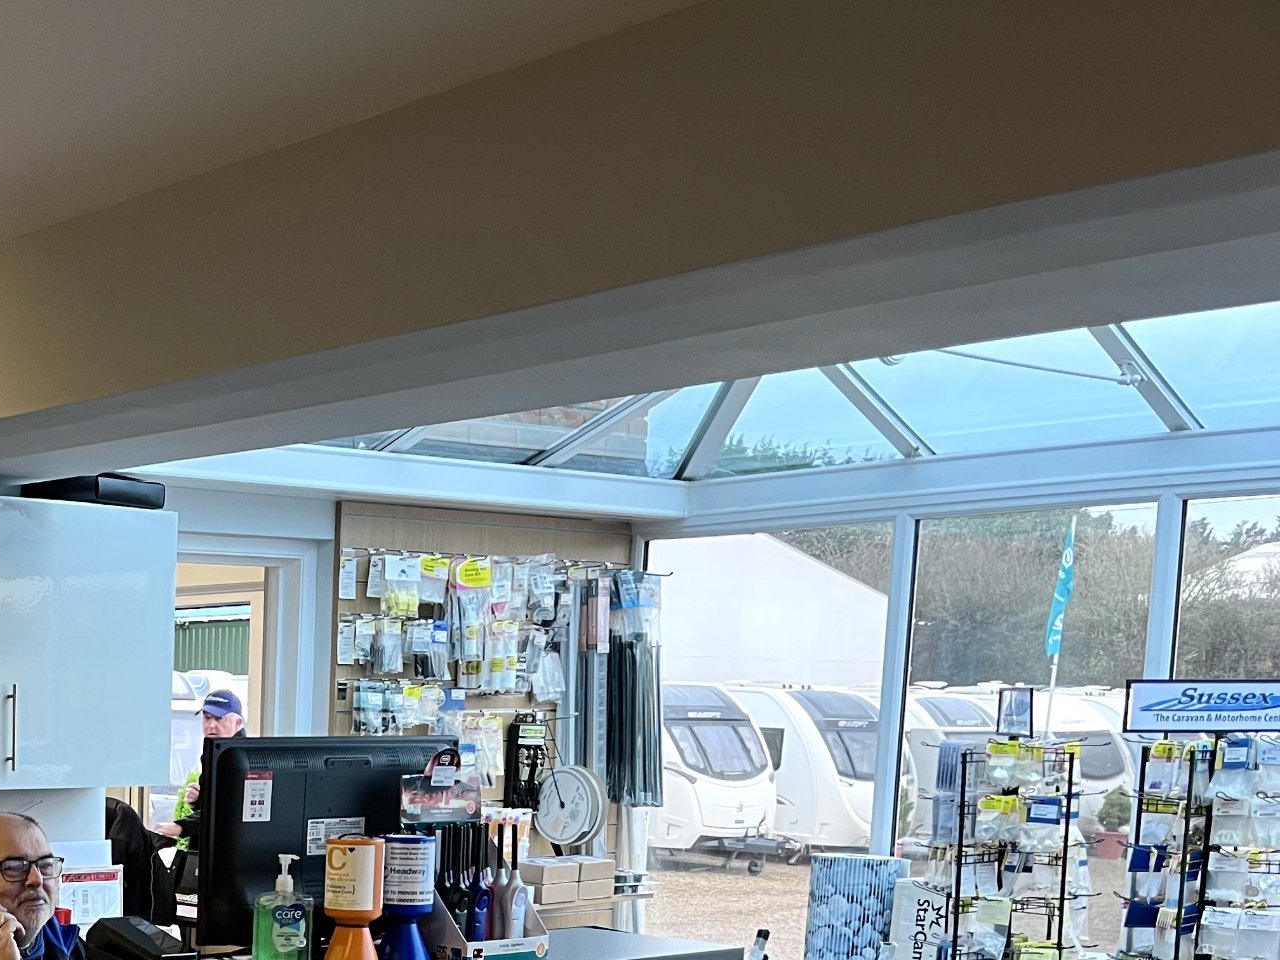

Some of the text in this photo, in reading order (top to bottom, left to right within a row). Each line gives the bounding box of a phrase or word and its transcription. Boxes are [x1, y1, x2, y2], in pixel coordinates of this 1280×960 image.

[1177, 687, 1274, 705] Sussex
[1171, 714, 1204, 722] Caravan
[1206, 714, 1213, 722] &
[1214, 714, 1262, 722] Motorhome
[389, 867, 426, 876] Headway
[275, 910, 303, 919] care
